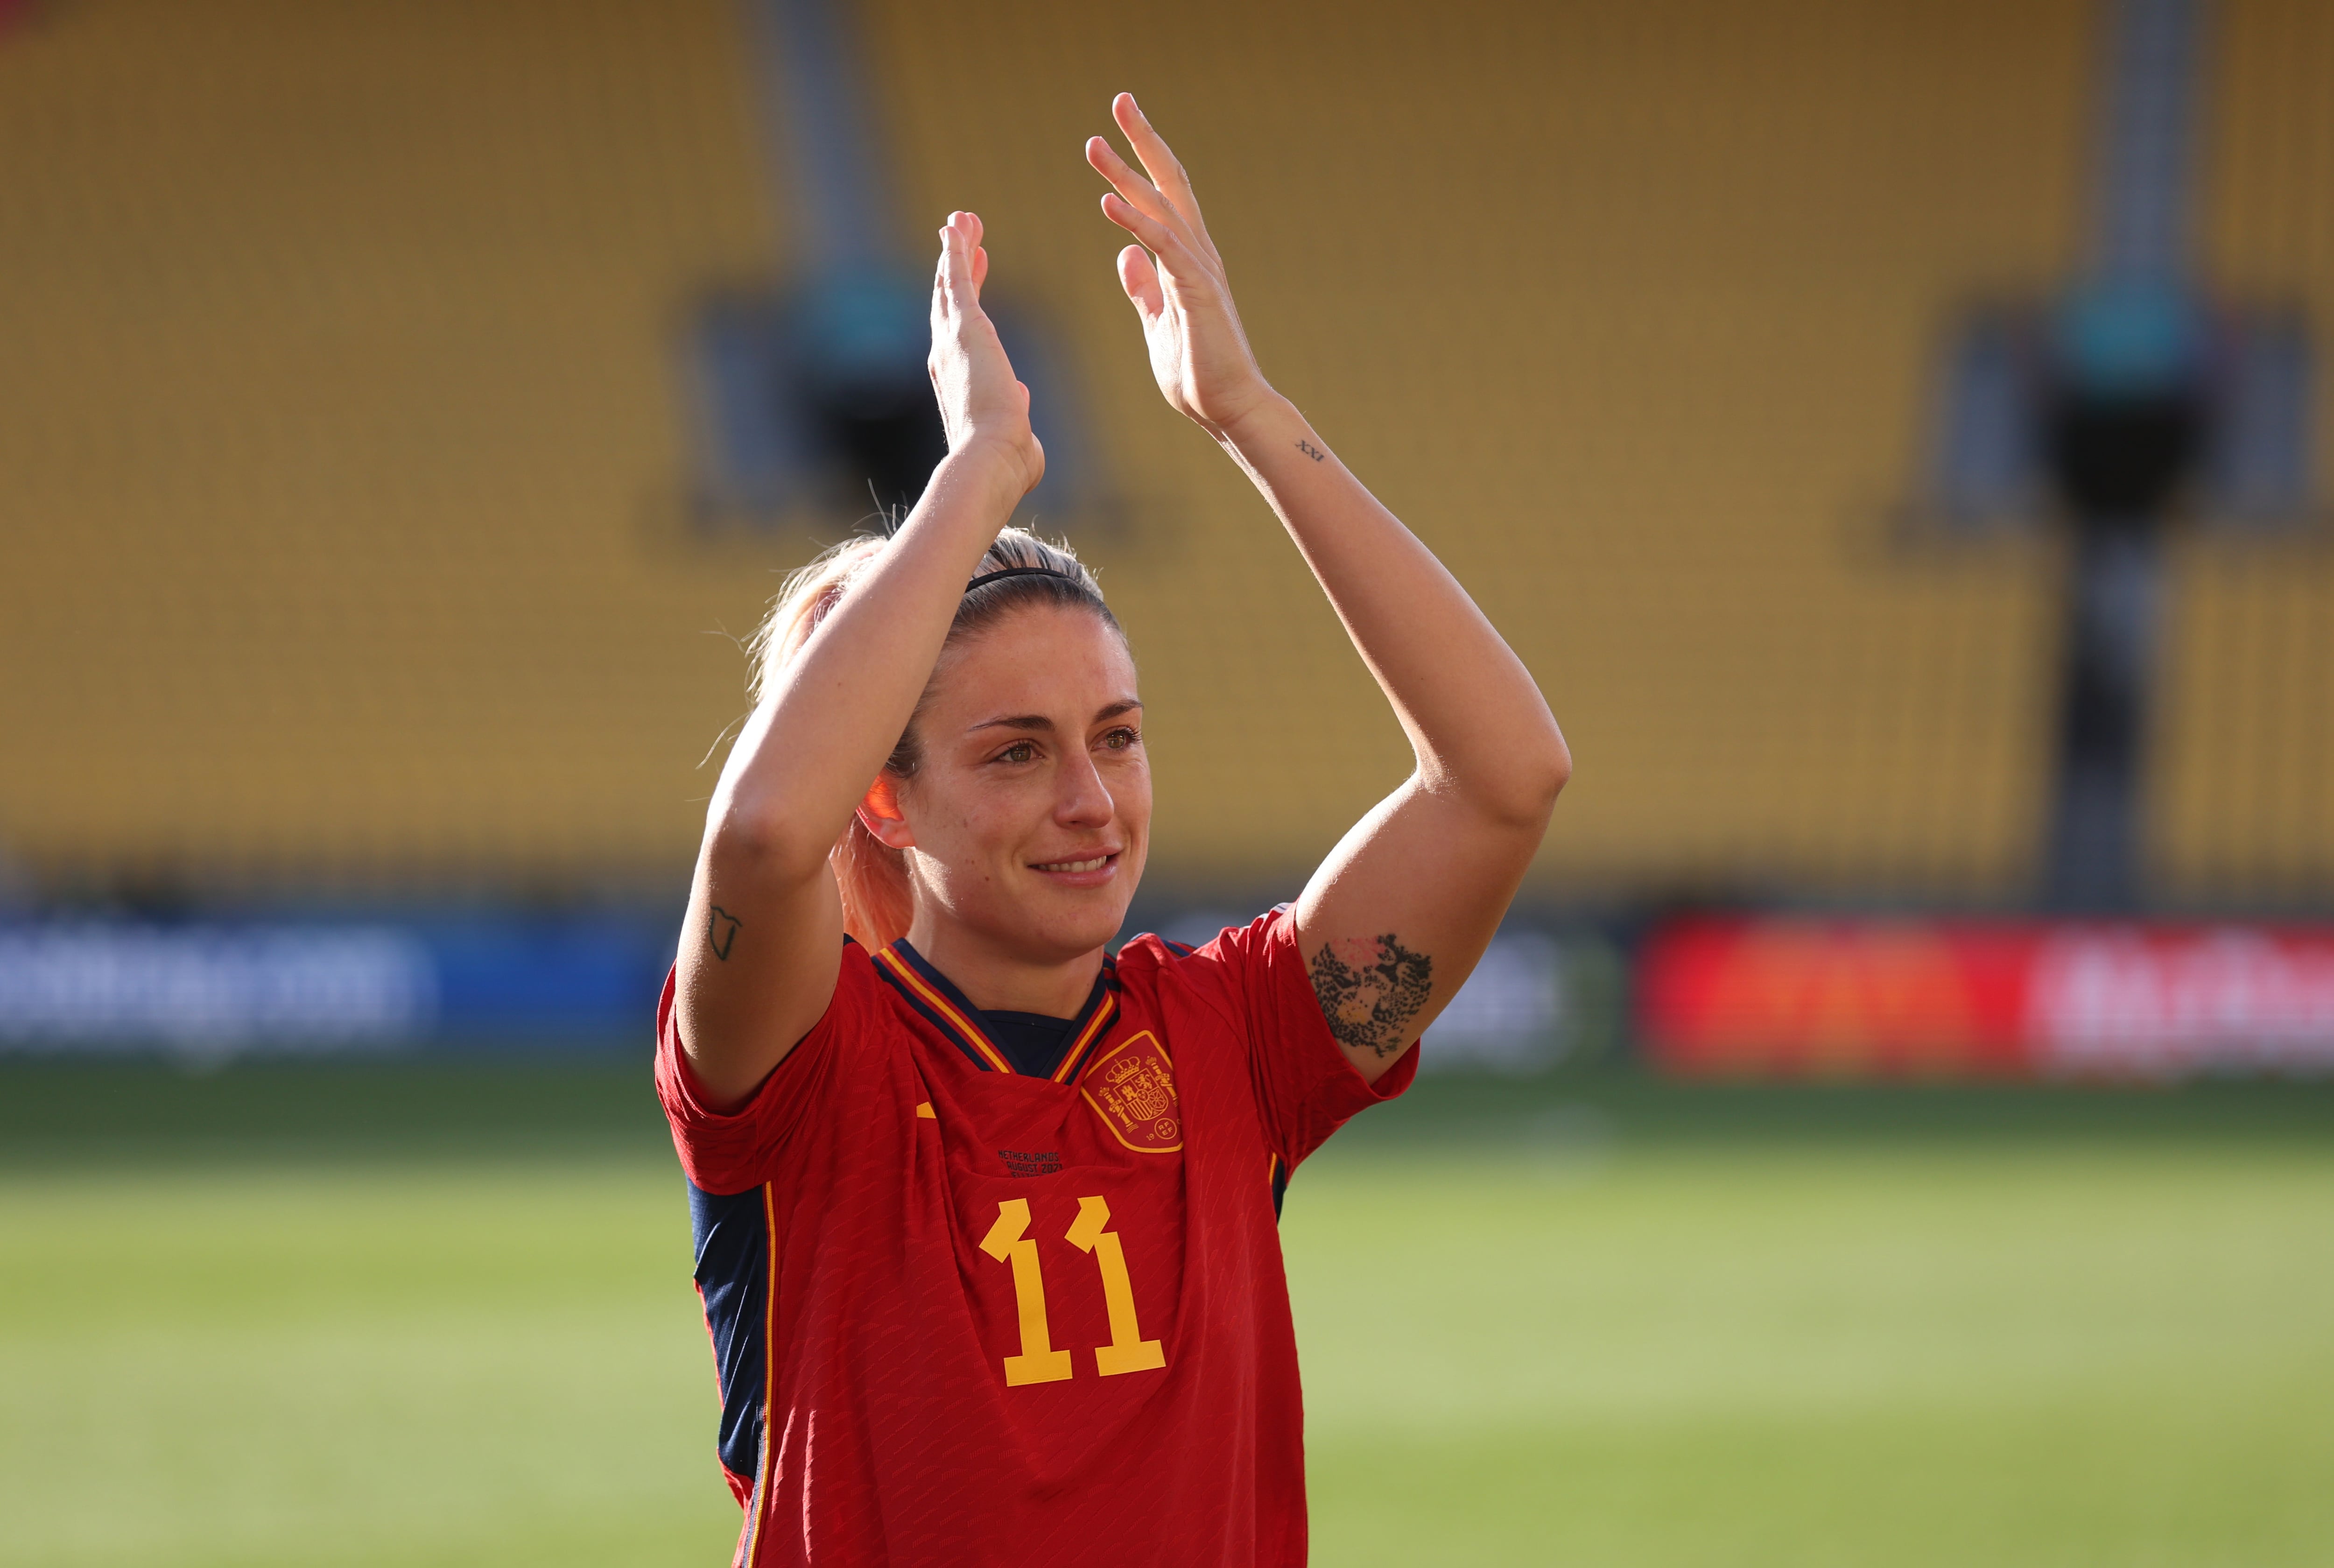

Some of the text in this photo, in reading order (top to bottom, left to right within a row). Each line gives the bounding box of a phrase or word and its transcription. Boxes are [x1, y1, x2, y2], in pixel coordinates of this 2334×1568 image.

[1295, 440, 1324, 462] XXI
[998, 1150, 1059, 1162] NETHERLANDS
[1007, 1161, 1037, 1173] AUGUST
[979, 1195, 1166, 1387] 11
